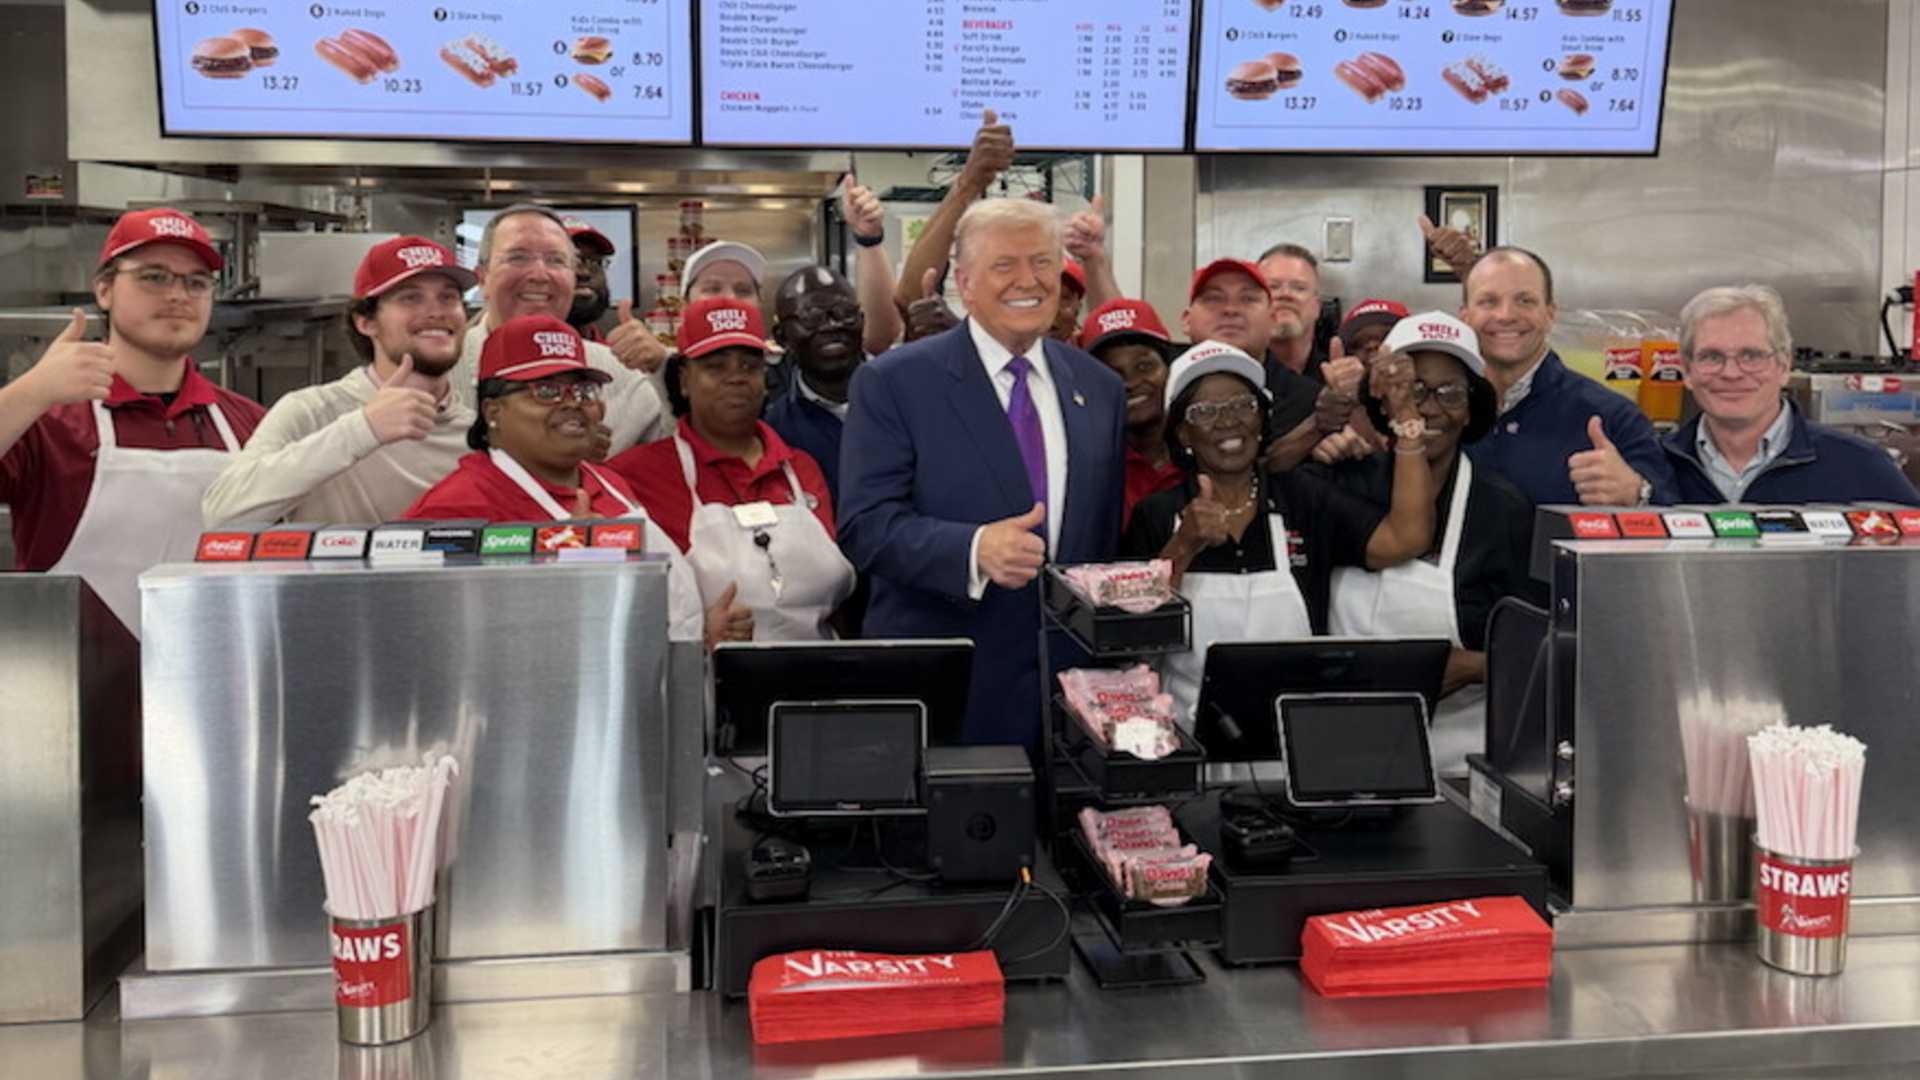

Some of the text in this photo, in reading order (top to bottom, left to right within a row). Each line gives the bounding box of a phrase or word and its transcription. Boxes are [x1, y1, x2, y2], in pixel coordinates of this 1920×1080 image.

[1289, 6, 1323, 19] 12.49
[1398, 7, 1430, 20] 14.24
[1505, 8, 1538, 21] 14.57
[1612, 9, 1642, 22] 11.55
[962, 20, 1014, 30] BEVERAGES
[632, 53, 663, 66] 8.70
[610, 66, 625, 77] or
[1611, 68, 1639, 81] 8.70
[263, 76, 299, 91] 13.27
[384, 79, 422, 93] 10.23
[511, 82, 543, 96] 11.57
[633, 85, 663, 99] 7.64
[1284, 97, 1317, 110] 13.27
[1389, 98, 1422, 111] 10.23
[1499, 99, 1529, 112] 11.57
[1608, 99, 1635, 112] 7.64
[397, 246, 443, 260] CHILI
[405, 256, 443, 268] DOG
[706, 308, 748, 323] CHILI
[1097, 309, 1137, 324] CHILI
[711, 319, 747, 333] DOG
[1101, 319, 1134, 334] DOG
[1417, 322, 1461, 339] CHILI
[533, 331, 577, 347] CHILI
[540, 343, 577, 358] DOG
[1809, 518, 1846, 529] WATER
[374, 540, 419, 550] WATER
[484, 533, 530, 548] Sprite
[1759, 861, 1850, 898] STRAWS
[1325, 901, 1481, 944] VARSITY
[331, 932, 401, 962] RAWS
[786, 953, 956, 978] VARSITY
